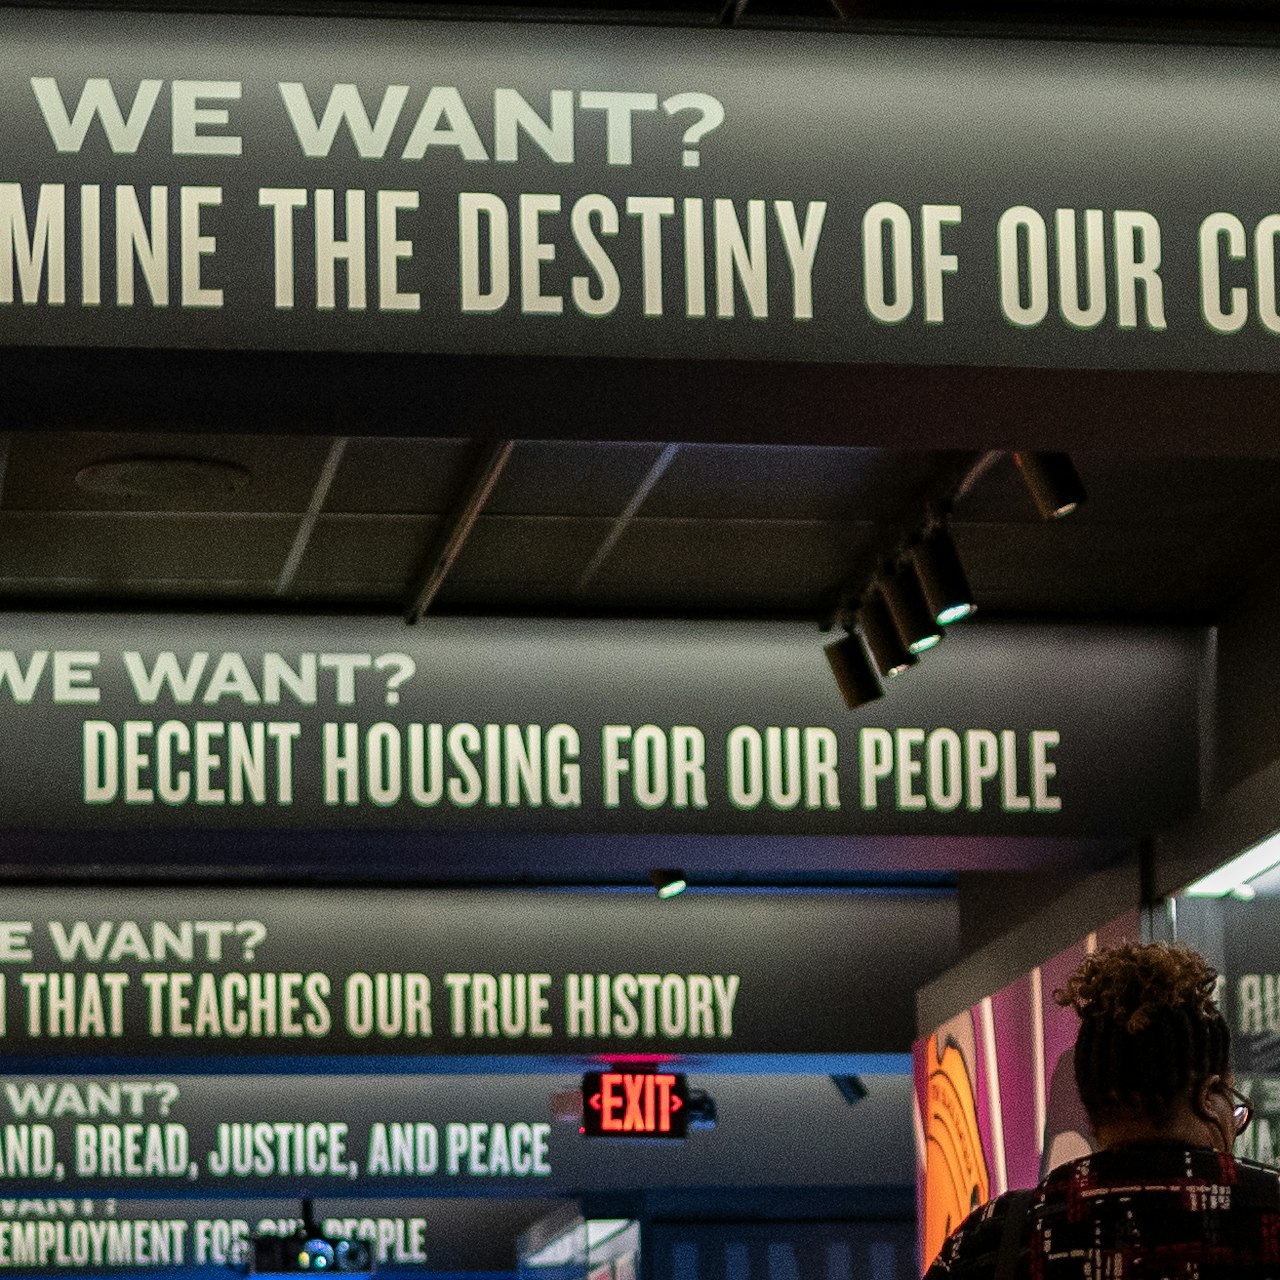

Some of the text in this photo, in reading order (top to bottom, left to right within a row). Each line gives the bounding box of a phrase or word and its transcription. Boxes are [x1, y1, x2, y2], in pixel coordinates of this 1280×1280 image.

[31, 76, 242, 155] WE
[278, 82, 725, 168] WANT?
[258, 188, 420, 310] THE
[459, 192, 827, 319] DESTINY
[862, 201, 962, 322] OF
[998, 205, 1166, 328] OUR
[122, 650, 417, 704] WANT?
[84, 720, 1060, 810] DECENT HOUSING FOR OUR PEOPLE
[48, 920, 267, 961] WANT?
[21, 972, 129, 1036] THAT
[143, 972, 330, 1036] TEACHES
[347, 973, 431, 1036] OUR
[445, 974, 551, 1036] TRUE
[567, 974, 740, 1036] HISTORY
[5, 1082, 180, 1117] WANT?
[602, 1074, 675, 1131] EXIT
[76, 1124, 198, 1180] BREAD,
[210, 1123, 358, 1179] JUSTICE,
[369, 1123, 437, 1174] AND
[447, 1123, 551, 1174] PEACE
[195, 1219, 250, 1265] FOR
